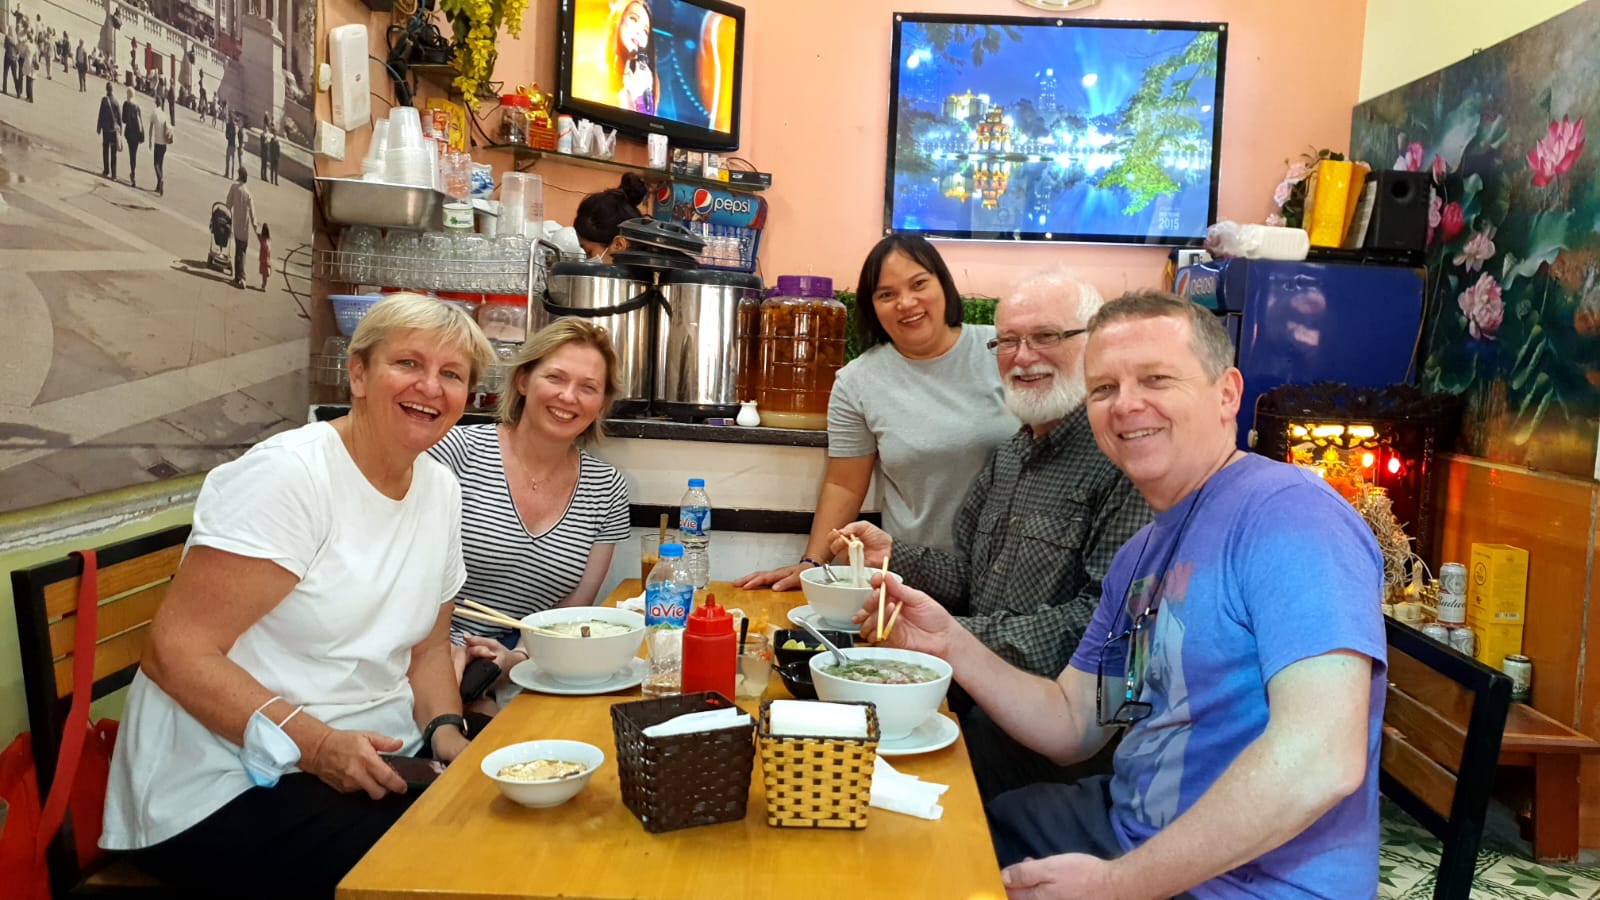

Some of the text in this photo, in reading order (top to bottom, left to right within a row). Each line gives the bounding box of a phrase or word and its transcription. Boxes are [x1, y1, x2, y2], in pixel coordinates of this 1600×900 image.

[714, 197, 751, 214] pepsi
[1158, 218, 1180, 230] 2015
[649, 602, 685, 618] laVie
